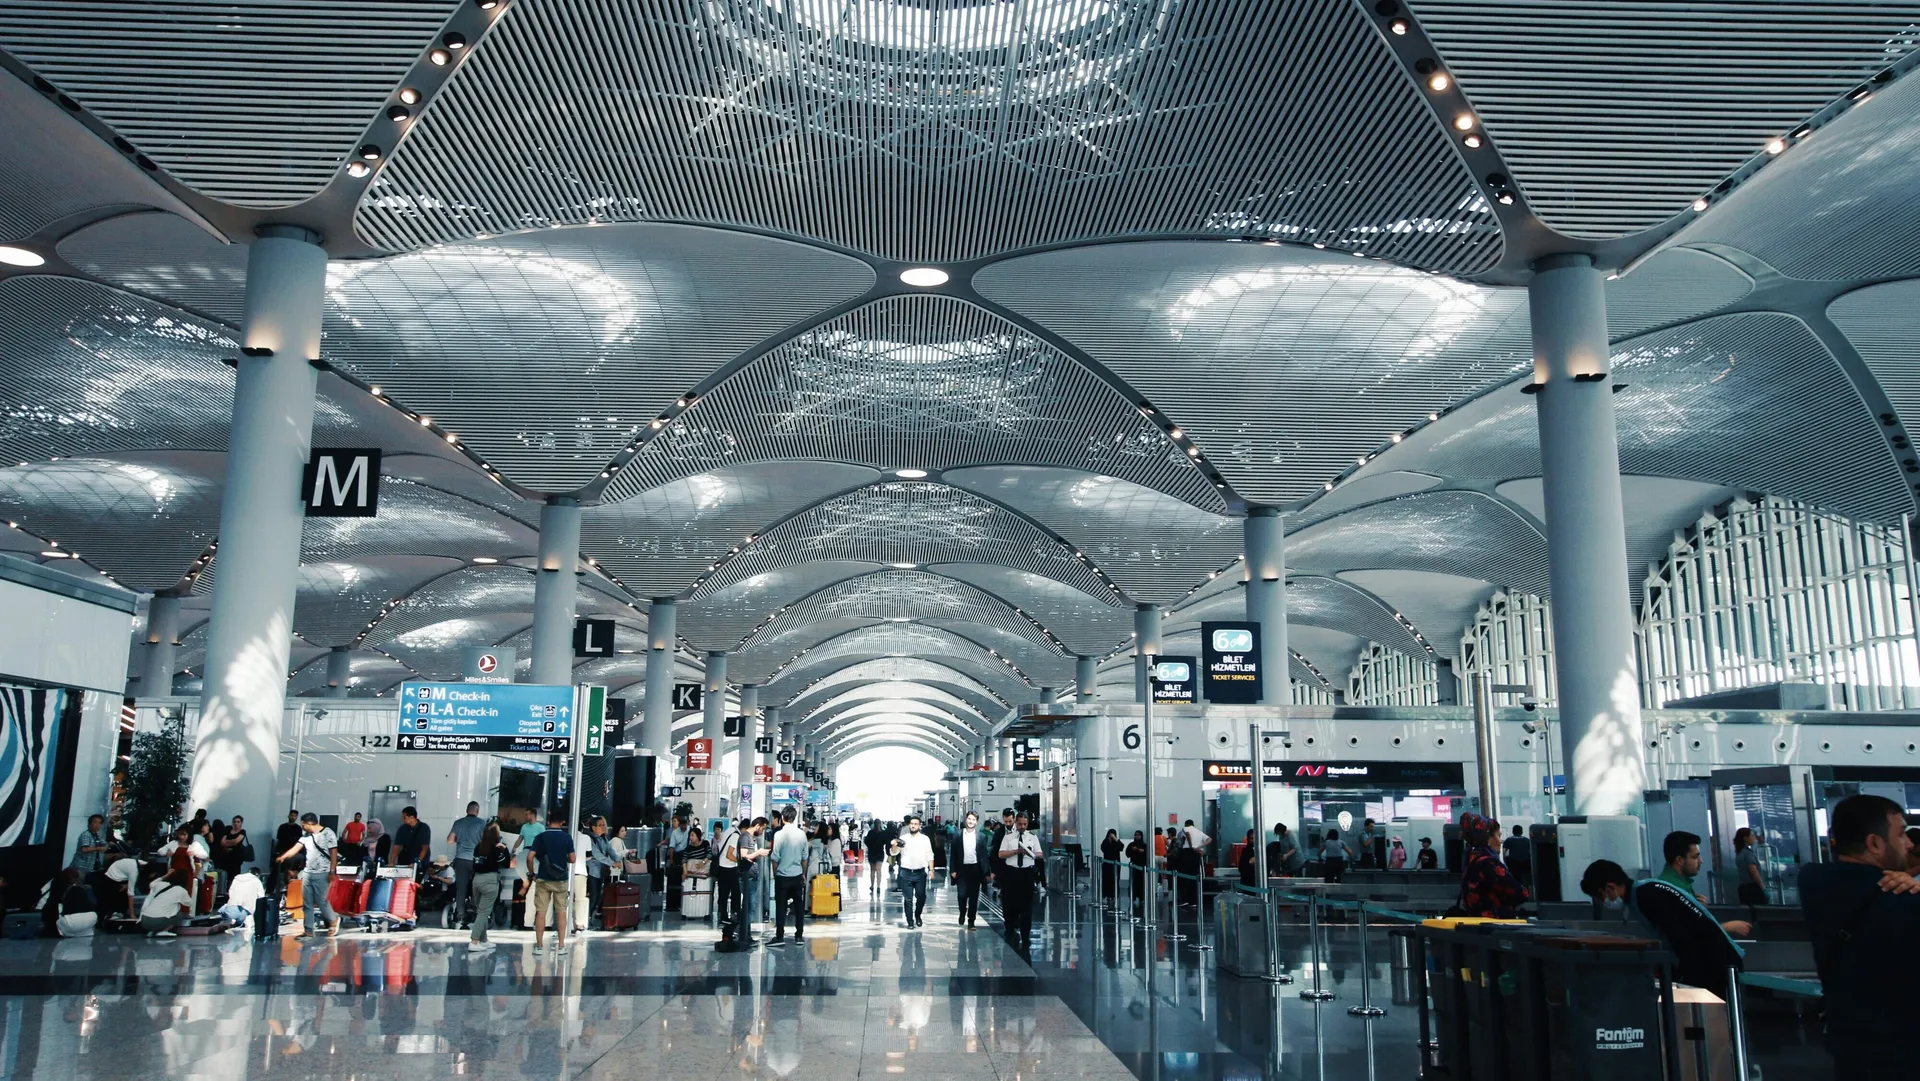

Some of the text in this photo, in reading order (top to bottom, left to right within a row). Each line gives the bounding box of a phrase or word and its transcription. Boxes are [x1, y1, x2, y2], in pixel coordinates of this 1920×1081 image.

[311, 455, 369, 507] M
[586, 624, 603, 652] L
[1217, 632, 1229, 649] 6
[1222, 654, 1244, 663] BİLET
[1159, 665, 1170, 678] 6
[1211, 663, 1256, 672] HİZMETLERİ
[1165, 683, 1182, 691] BİLET
[432, 687, 490, 702] M Check-in
[679, 687, 695, 708] K
[1155, 690, 1192, 698] HİZMETLERİ
[431, 703, 499, 717] L-A Check-in
[444, 718, 457, 726] gidiş
[519, 720, 541, 728] Otopark
[731, 717, 740, 735] J
[529, 727, 541, 735] park
[1122, 724, 1141, 749] 6
[360, 735, 391, 748] 1-22
[428, 736, 442, 744] Vergi
[759, 738, 770, 752] H
[457, 743, 471, 751] only)
[780, 751, 790, 763] G
[796, 760, 802, 770] F
[1327, 766, 1368, 775] Nordwind
[807, 768, 813, 777] E
[684, 777, 695, 790] K
[987, 780, 995, 792] 5
